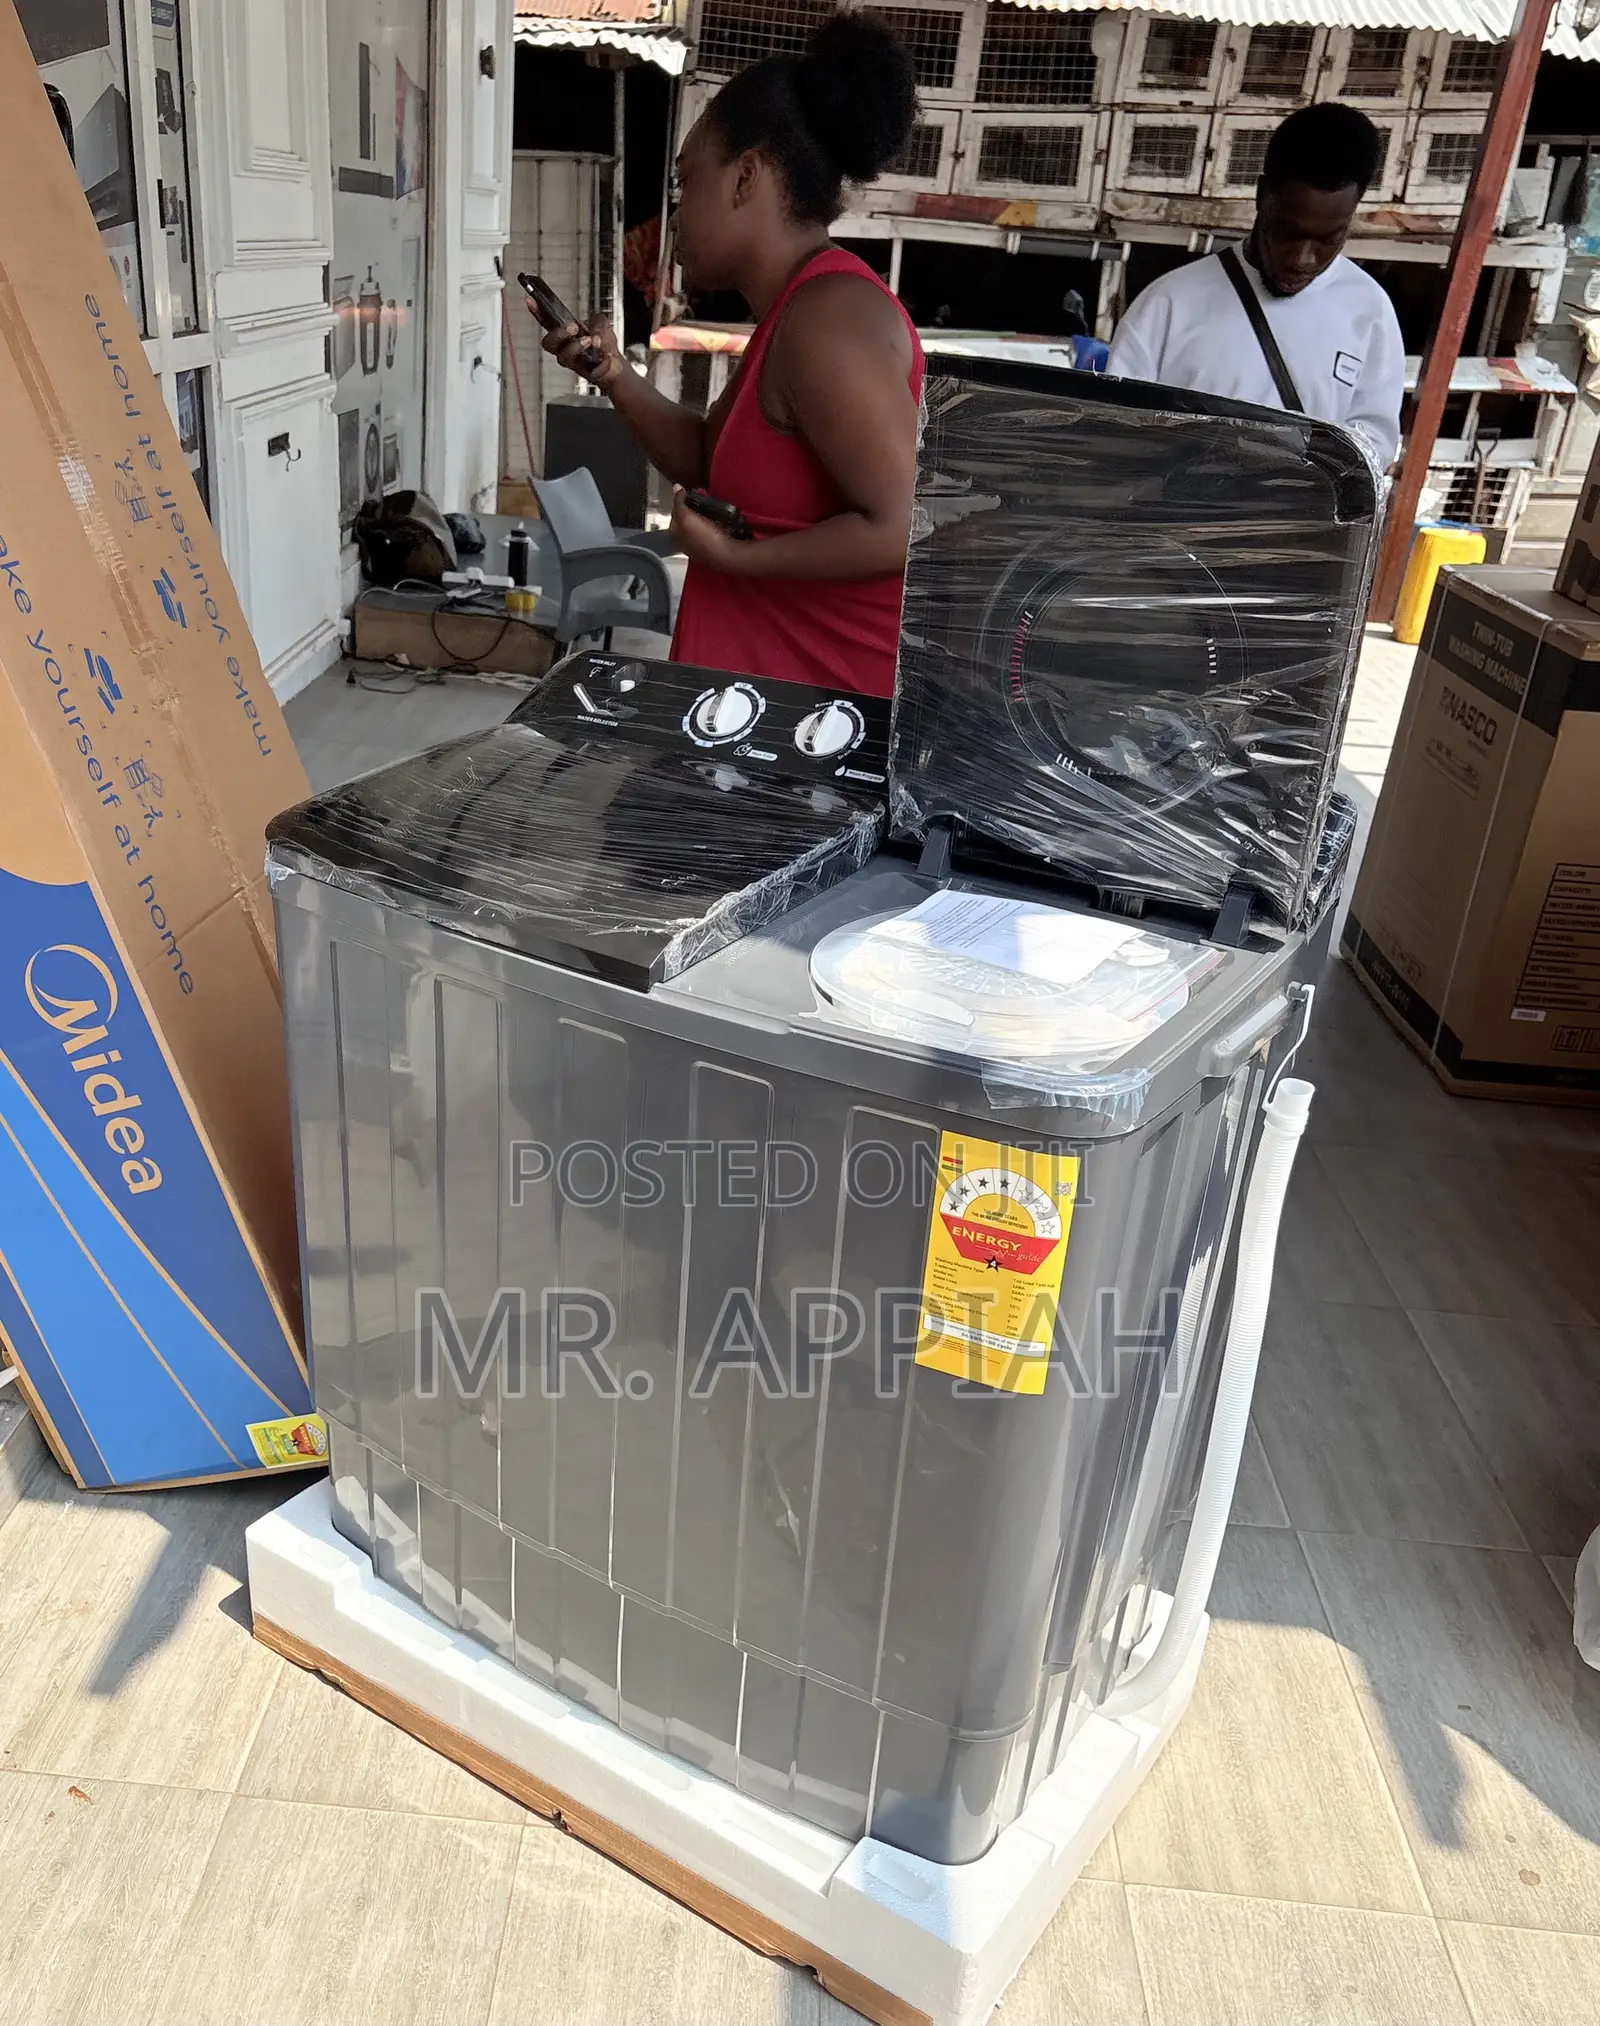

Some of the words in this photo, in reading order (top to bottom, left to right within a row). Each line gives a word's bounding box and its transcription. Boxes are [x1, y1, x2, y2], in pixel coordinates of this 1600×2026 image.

[85, 293, 141, 417] home
[138, 432, 162, 471] at
[155, 486, 232, 645] yourself
[226, 655, 272, 757] make
[1485, 657, 1527, 695] MACHINE
[26, 629, 123, 809] yourself
[114, 823, 141, 867] at
[137, 874, 195, 996] home
[32, 975, 164, 1195] Midea
[952, 1226, 1022, 1252] ENERGY
[990, 1260, 997, 1268] 4
[1016, 1251, 1042, 1264] guide
